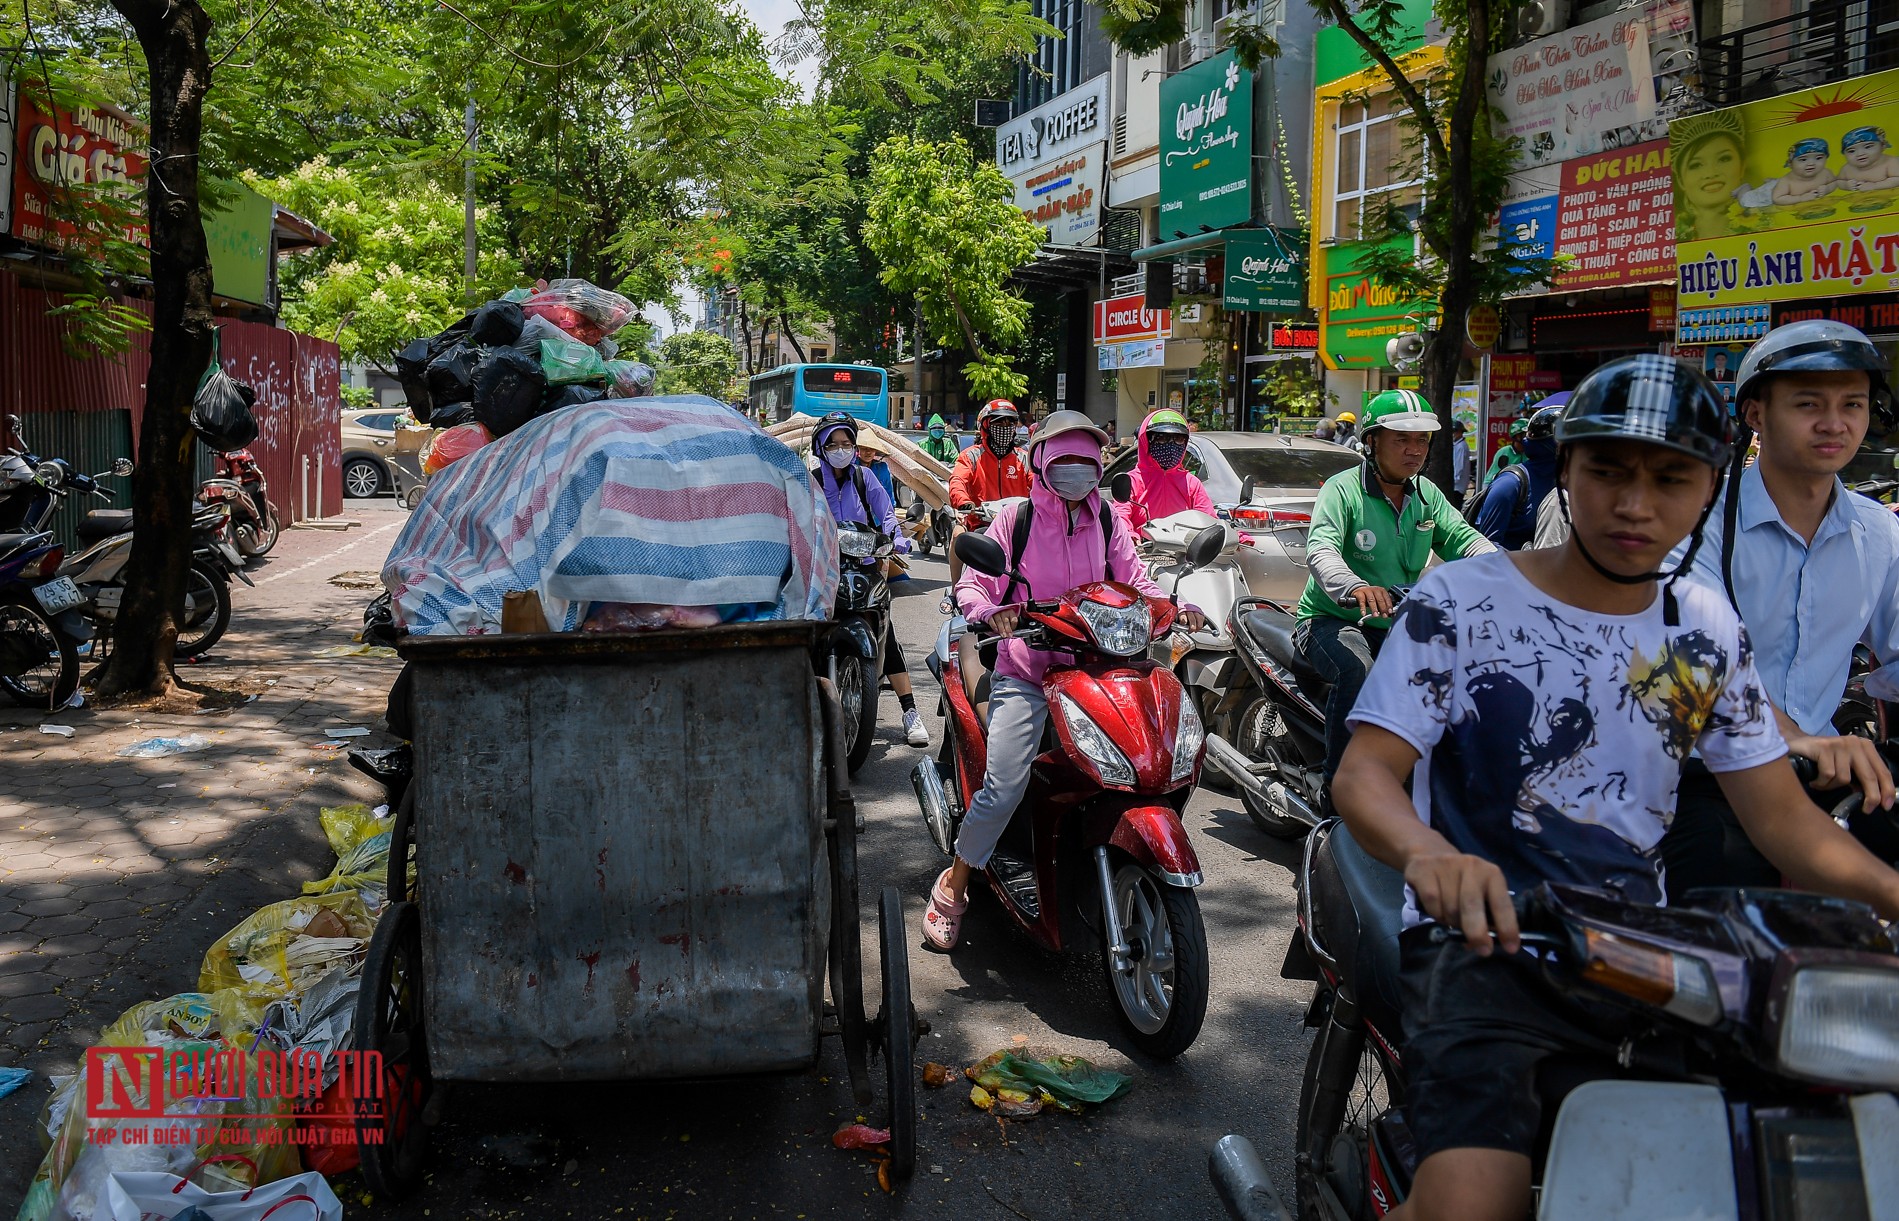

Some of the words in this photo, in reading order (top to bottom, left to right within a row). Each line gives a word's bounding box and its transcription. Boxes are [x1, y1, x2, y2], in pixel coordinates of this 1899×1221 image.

[1512, 54, 1541, 77] Phun
[1177, 94, 1206, 141] Quỳnh
[1204, 87, 1228, 128] Hoa
[1582, 99, 1602, 127] Spa
[1614, 84, 1640, 113] Nail
[78, 107, 102, 141] Phụ
[107, 116, 132, 151] Kiện
[999, 132, 1023, 165] TEA
[1045, 96, 1097, 145] COFFEE
[1201, 132, 1225, 150] Flower
[1225, 125, 1239, 148] shop
[35, 125, 86, 187] Giá
[1575, 159, 1622, 185] ĐỨC
[24, 192, 41, 214] Sửa
[1563, 190, 1596, 207] PHOTO
[1606, 184, 1629, 199] VĂN
[1631, 175, 1672, 194] PHÒNG
[1562, 207, 1583, 224] QUÀ
[1587, 203, 1616, 221] TẶNG
[1627, 198, 1641, 212] IN
[1560, 226, 1577, 240] GHI
[1580, 222, 1598, 237] ĐĨA
[1608, 216, 1638, 233] SCAN
[1649, 210, 1671, 227] ĐẶT
[1559, 241, 1587, 255] PHONG
[1589, 237, 1599, 252] BÌ
[1606, 233, 1632, 250] THIỆP
[1634, 228, 1656, 245] CƯỚI
[1242, 256, 1270, 275] Quỳnh
[1268, 258, 1290, 274] Hoa
[1584, 252, 1617, 270] THUẬT
[1627, 247, 1659, 264] CÔNG
[1679, 252, 1738, 299] HIỆU
[1745, 241, 1803, 288] ẢNH
[1810, 227, 1899, 286] MẶT
[1330, 283, 1350, 311] ĐÔI
[1109, 309, 1138, 327] CIRCLE
[1491, 360, 1512, 376] PHUN
[1490, 421, 1507, 436] GỘI
[1353, 552, 1375, 561] Grab
